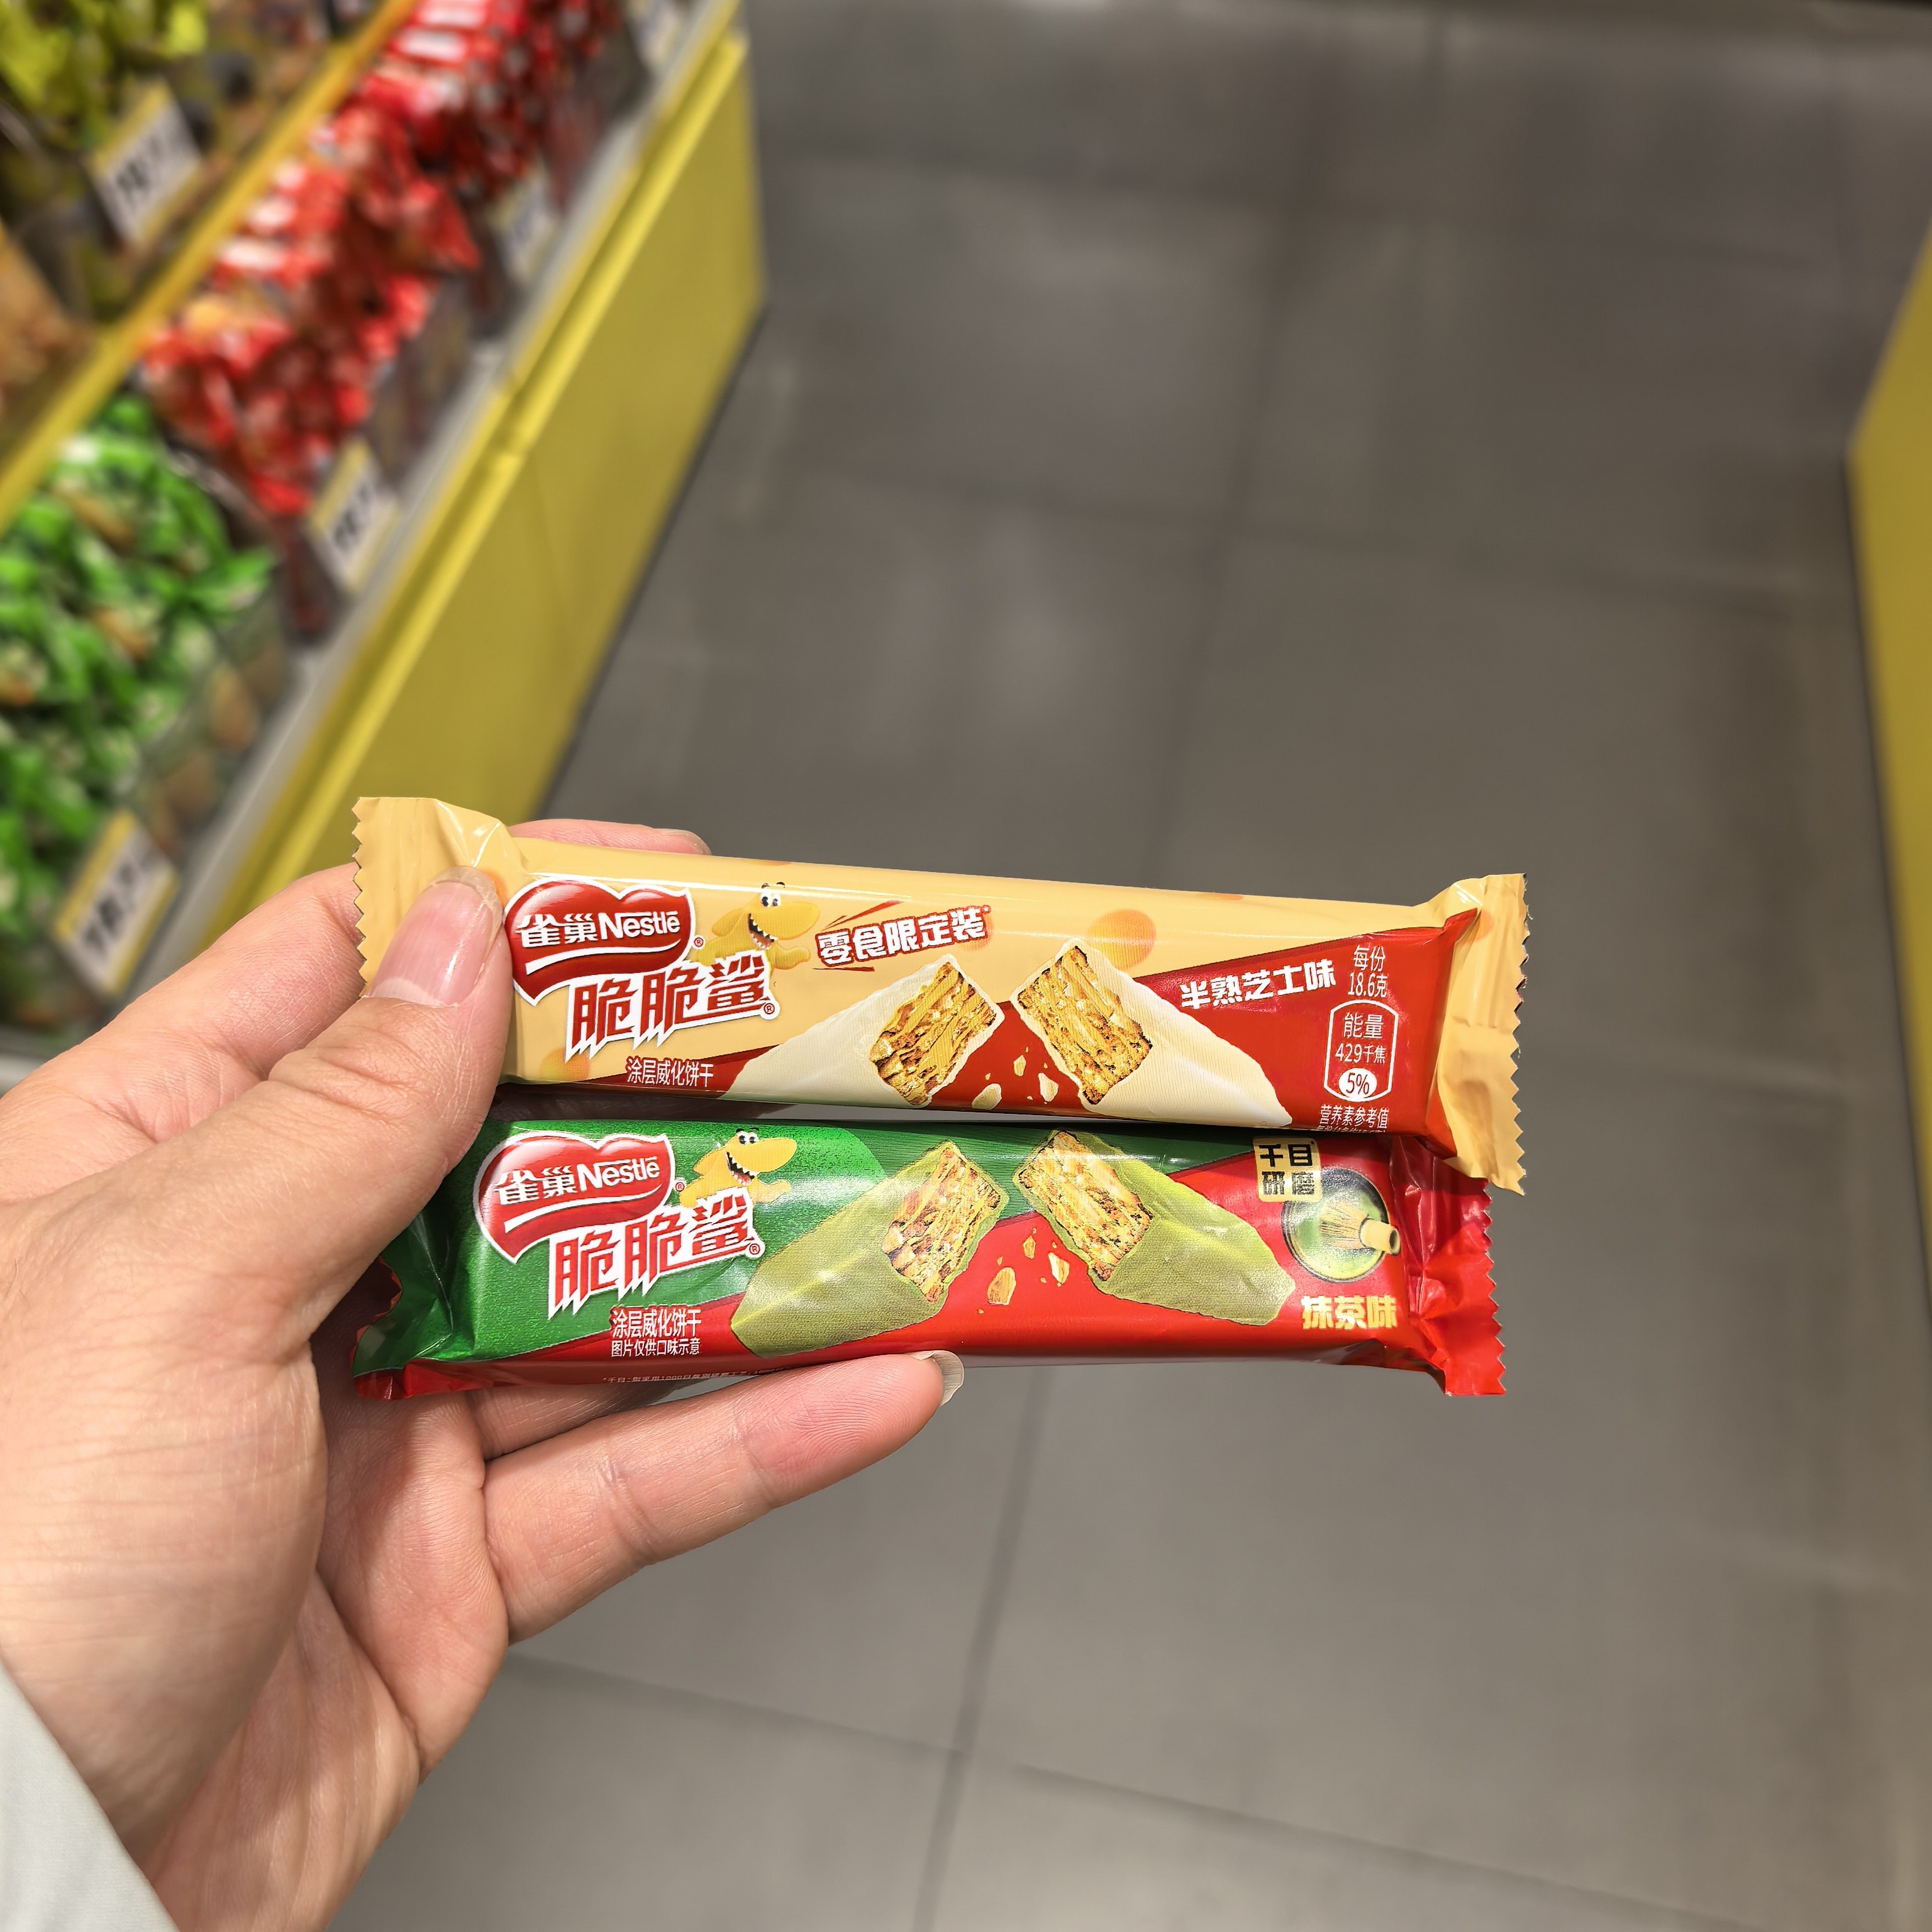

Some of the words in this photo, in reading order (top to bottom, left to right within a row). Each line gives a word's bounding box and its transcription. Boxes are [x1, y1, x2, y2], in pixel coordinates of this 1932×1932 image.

[516, 913, 597, 948] 雀巢
[1353, 945, 1387, 972] 每份
[1180, 958, 1336, 1010] 半熟芝士味
[1348, 972, 1388, 999] 18.6克
[570, 952, 772, 1050] 脆脆鲨
[1343, 1012, 1385, 1040] 能量
[1335, 1043, 1387, 1064] 429千焦
[626, 1058, 714, 1088] 涂层威化饼干
[1346, 1072, 1370, 1096] 5%
[1319, 1104, 1389, 1130] 营养素参考值
[1259, 1143, 1313, 1168] 千目
[494, 1165, 578, 1206] 雀巢
[553, 1193, 750, 1310] 脆脆鲨
[613, 1309, 702, 1338] 涂层威化饼干
[1301, 1295, 1398, 1331] 抹茶味
[611, 1337, 701, 1358] 图片仅供口味示意
